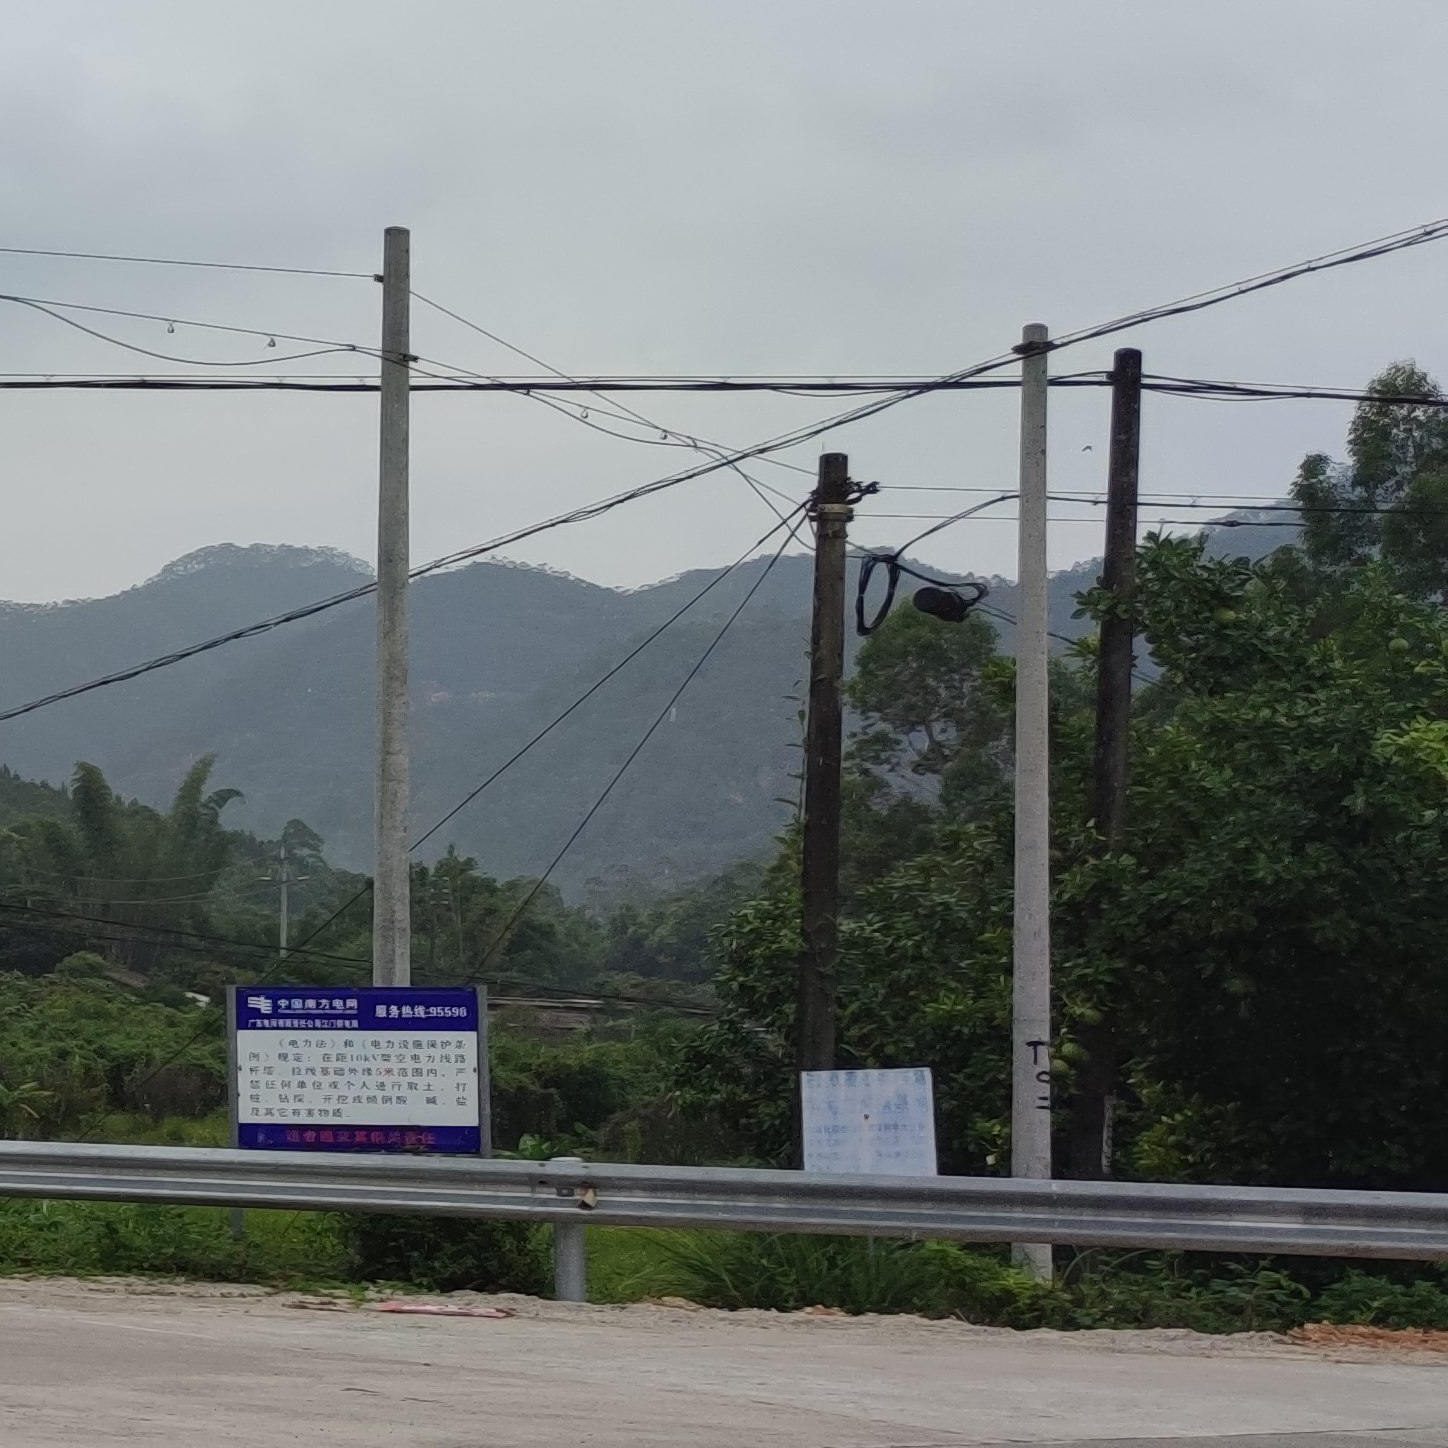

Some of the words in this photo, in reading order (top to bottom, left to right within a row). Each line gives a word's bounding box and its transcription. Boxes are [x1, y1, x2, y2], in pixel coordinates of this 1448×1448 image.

[277, 998, 358, 1010] 中国南方电网
